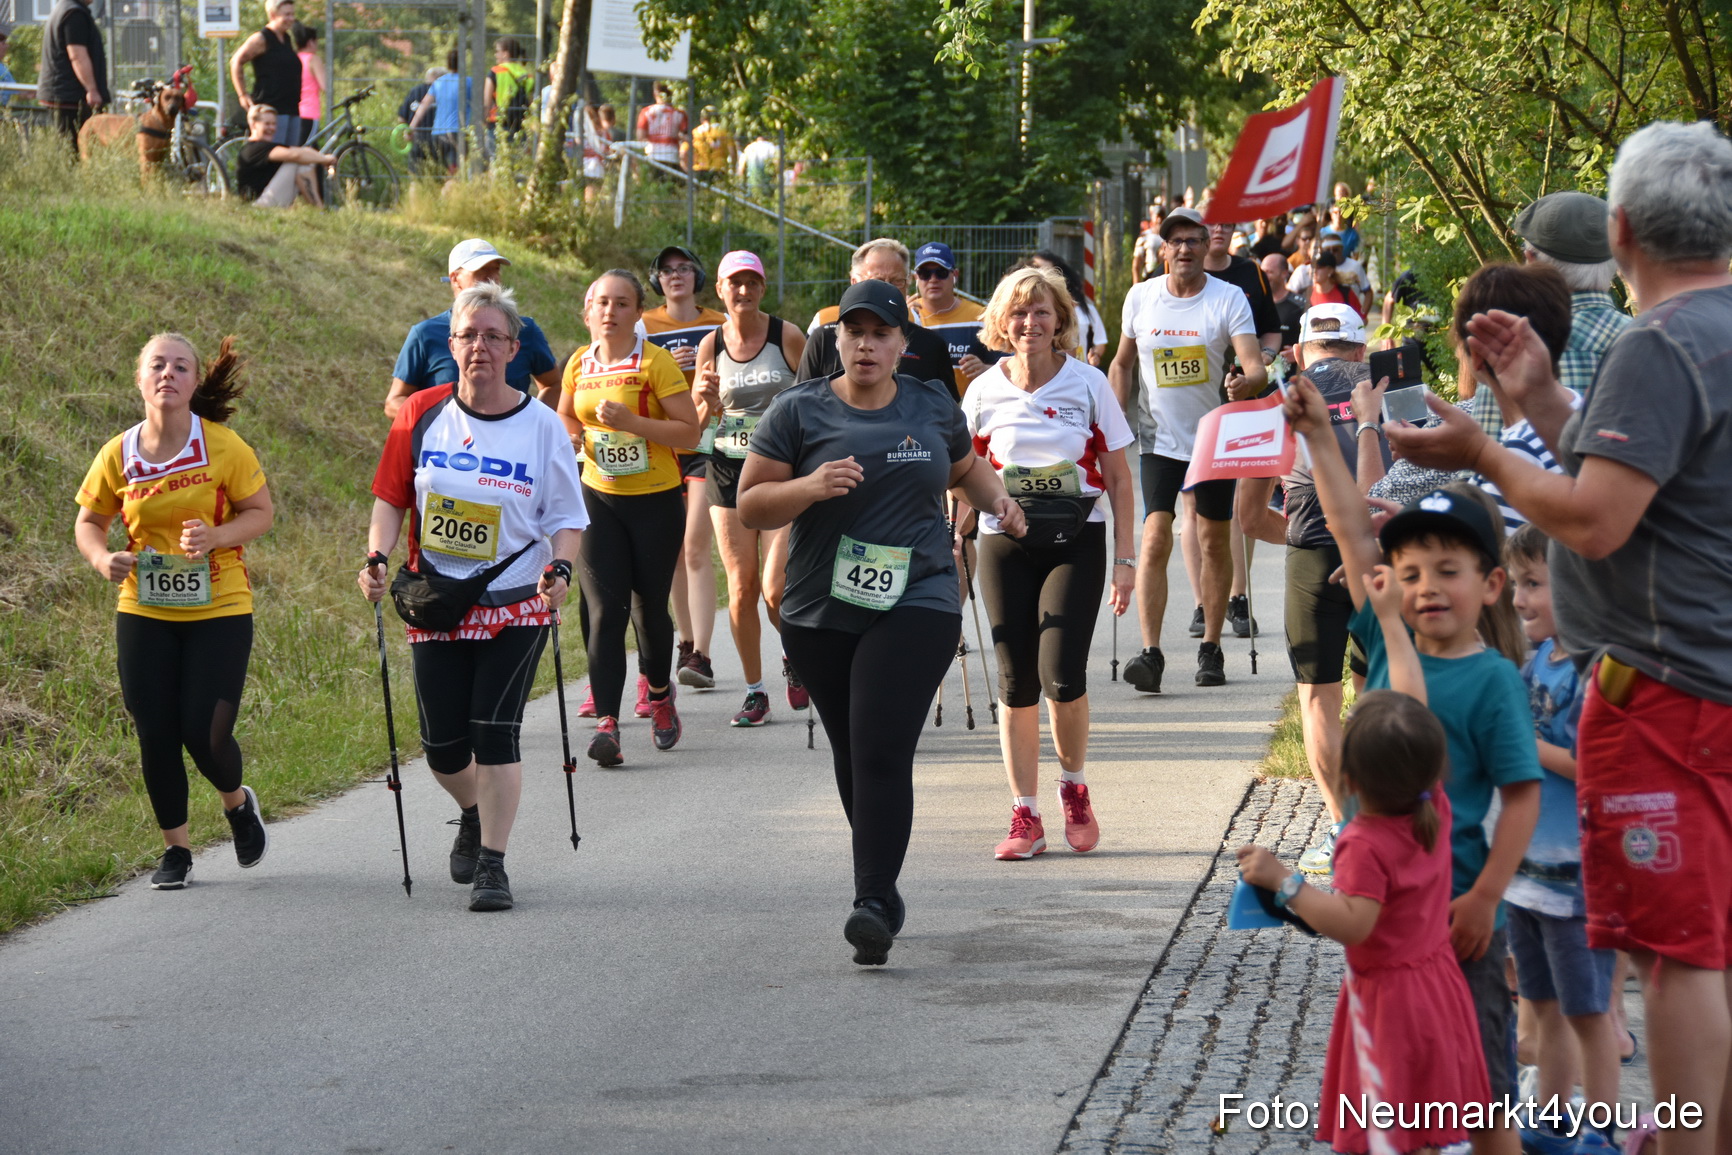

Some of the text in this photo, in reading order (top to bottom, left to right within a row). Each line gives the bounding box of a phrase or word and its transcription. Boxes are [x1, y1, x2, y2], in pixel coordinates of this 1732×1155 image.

[1161, 359, 1201, 376] 1158
[577, 376, 641, 391] MAX BÖGL
[731, 431, 753, 446] 18
[599, 446, 640, 463] 1583
[887, 451, 931, 459] BURKHARDT
[1211, 459, 1280, 468] DEHN protects.
[126, 472, 213, 501] MAX BÖGL
[478, 476, 532, 497] energie
[1020, 477, 1062, 491] 359
[431, 515, 488, 544] 2066
[454, 540, 477, 550] Claudia
[146, 571, 200, 592] 1665
[847, 564, 893, 592] 429
[468, 606, 514, 625] AVIA
